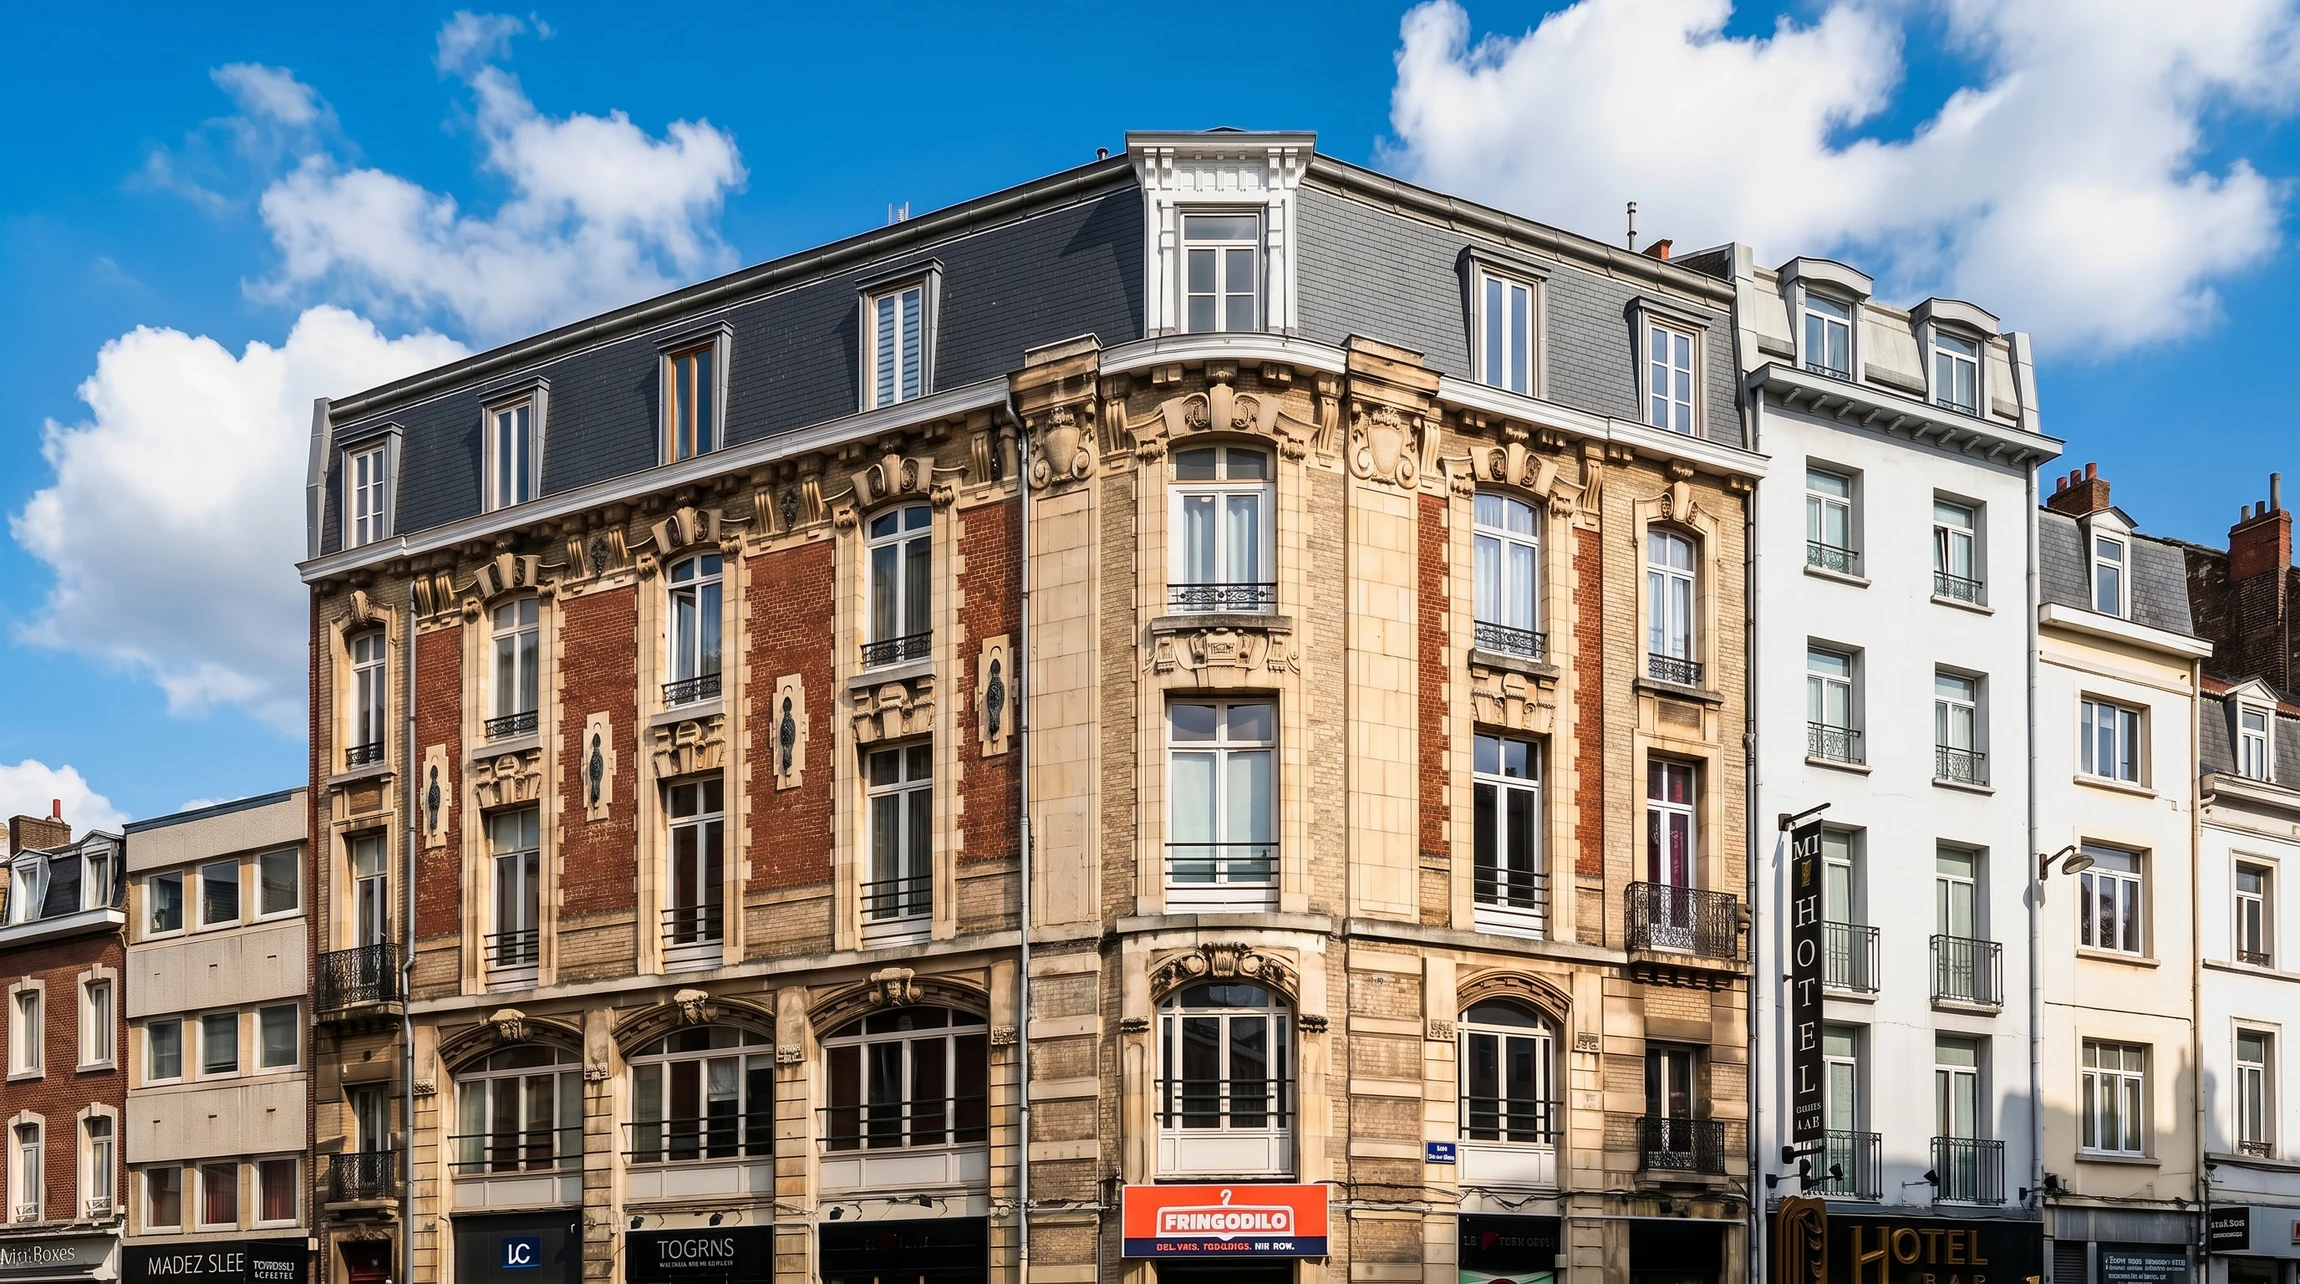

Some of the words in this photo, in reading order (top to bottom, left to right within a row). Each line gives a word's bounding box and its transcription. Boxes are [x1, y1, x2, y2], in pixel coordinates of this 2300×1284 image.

[1793, 834, 1819, 861] MI
[1795, 895, 1817, 1094] HOTEL
[1165, 1213, 1287, 1230] FRINGODILO
[656, 1238, 734, 1259] TOGRNS
[1850, 1226, 1988, 1284] HOTEL
[148, 1254, 203, 1275] MADEZ
[208, 1252, 244, 1273] SLEE
